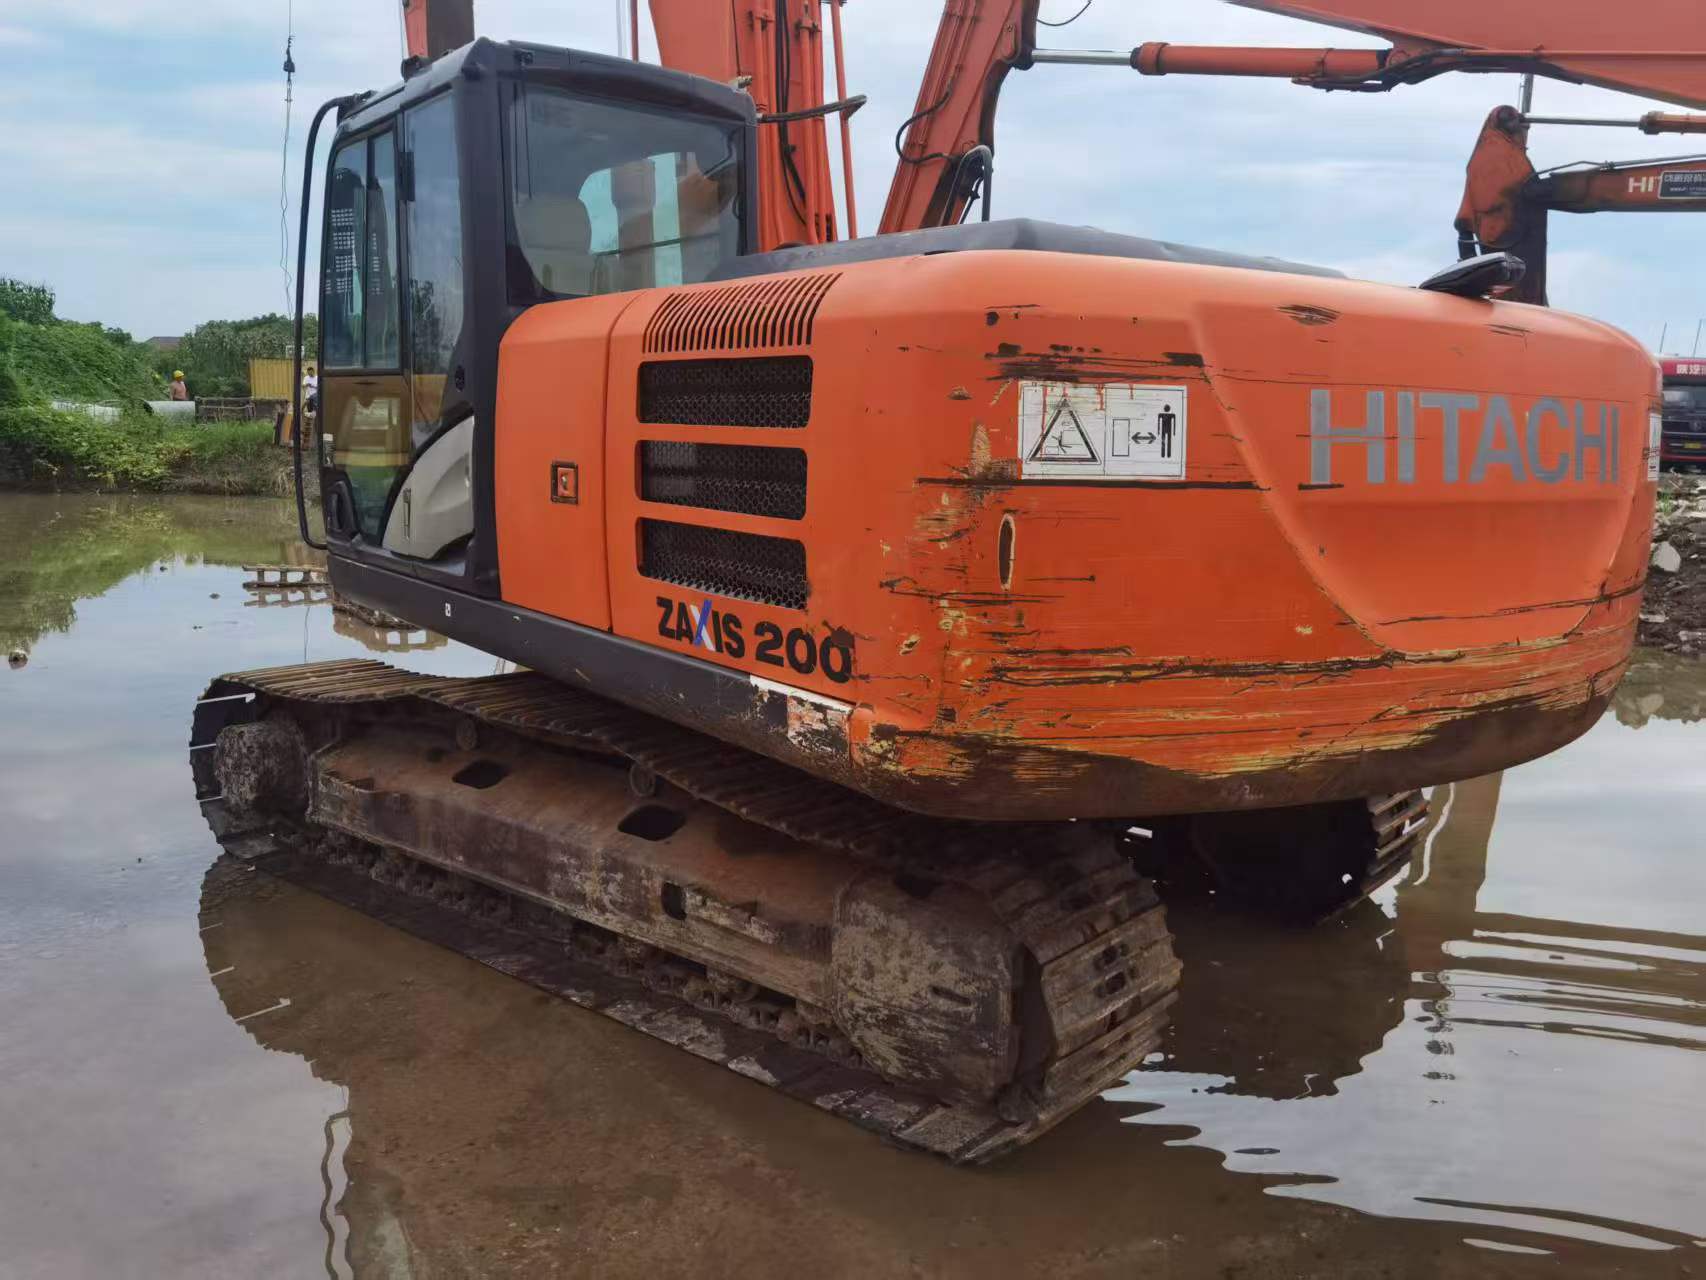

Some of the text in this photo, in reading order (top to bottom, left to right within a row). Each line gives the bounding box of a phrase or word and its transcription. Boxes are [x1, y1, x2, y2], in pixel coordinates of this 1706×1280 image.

[1310, 389, 1619, 484] HITACHI
[656, 596, 854, 683] ZAXIS 200
